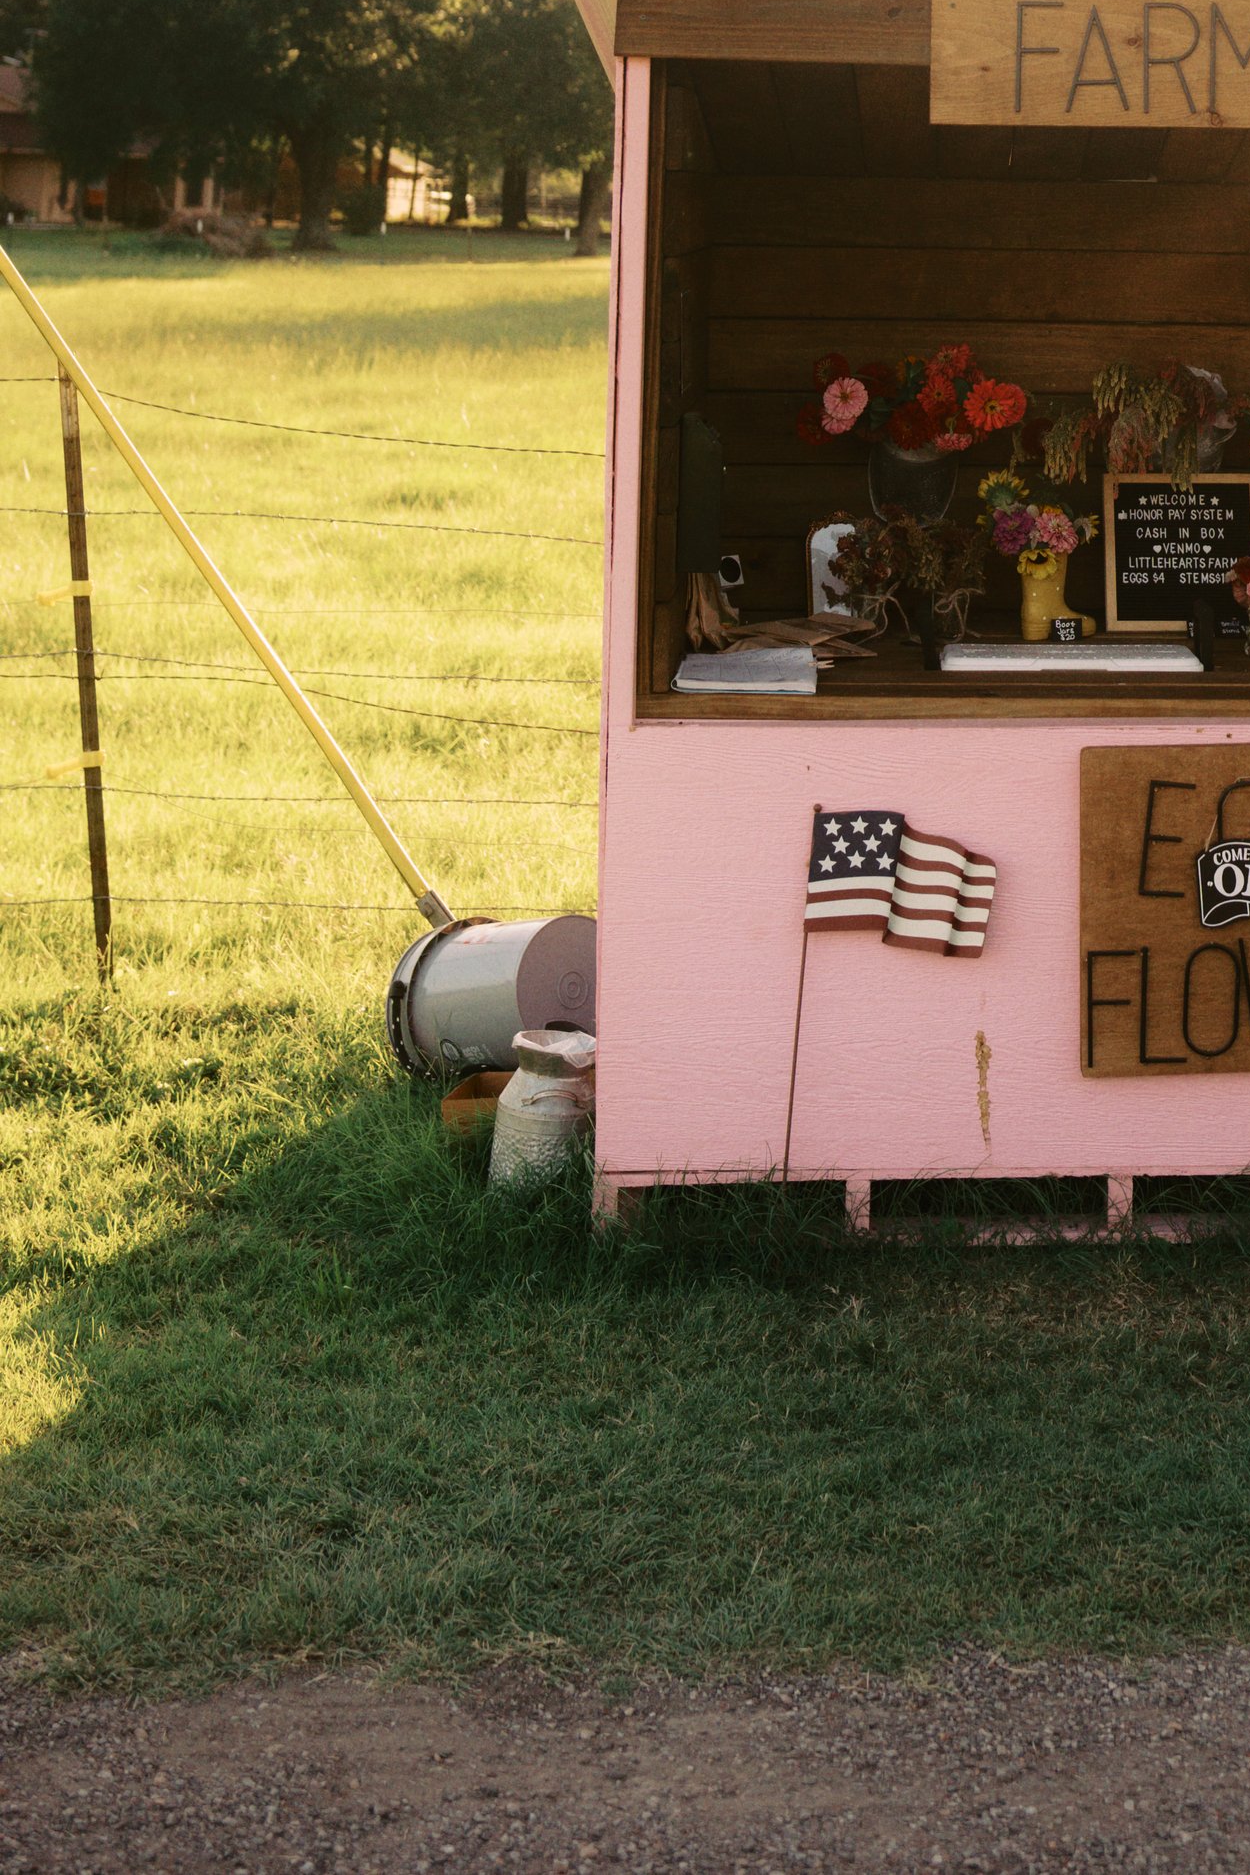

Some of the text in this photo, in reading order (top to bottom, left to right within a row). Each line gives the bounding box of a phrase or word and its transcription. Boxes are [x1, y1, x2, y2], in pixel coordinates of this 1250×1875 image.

[1149, 494, 1206, 506] WELCOME
[1129, 509, 1234, 521] HONOR PAY SYSTEM
[1136, 527, 1225, 539] CASH IN BOX
[1163, 542, 1201, 554] VENMO
[1122, 572, 1149, 584] EGGS
[1152, 572, 1165, 584] $4
[1055, 619, 1076, 629] Boot
[1213, 848, 1250, 866] COME
